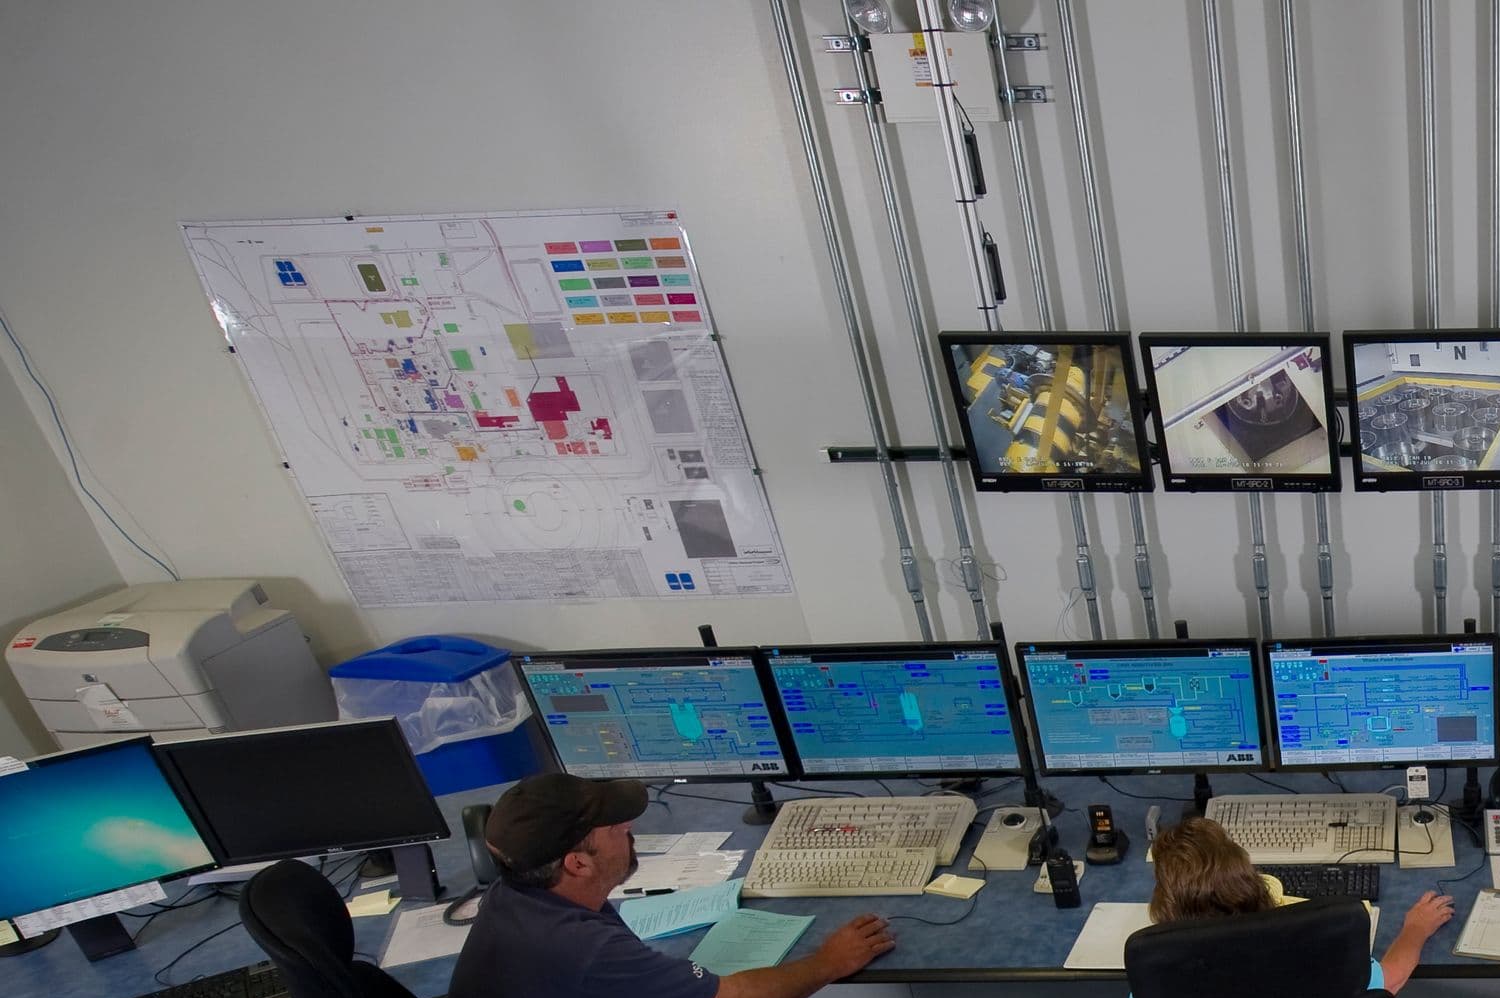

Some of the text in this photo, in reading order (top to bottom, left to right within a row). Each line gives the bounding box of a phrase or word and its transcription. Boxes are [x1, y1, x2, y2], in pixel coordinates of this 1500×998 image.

[1454, 345, 1467, 361] N
[1226, 753, 1255, 762] ABB
[751, 762, 780, 771] ABB
